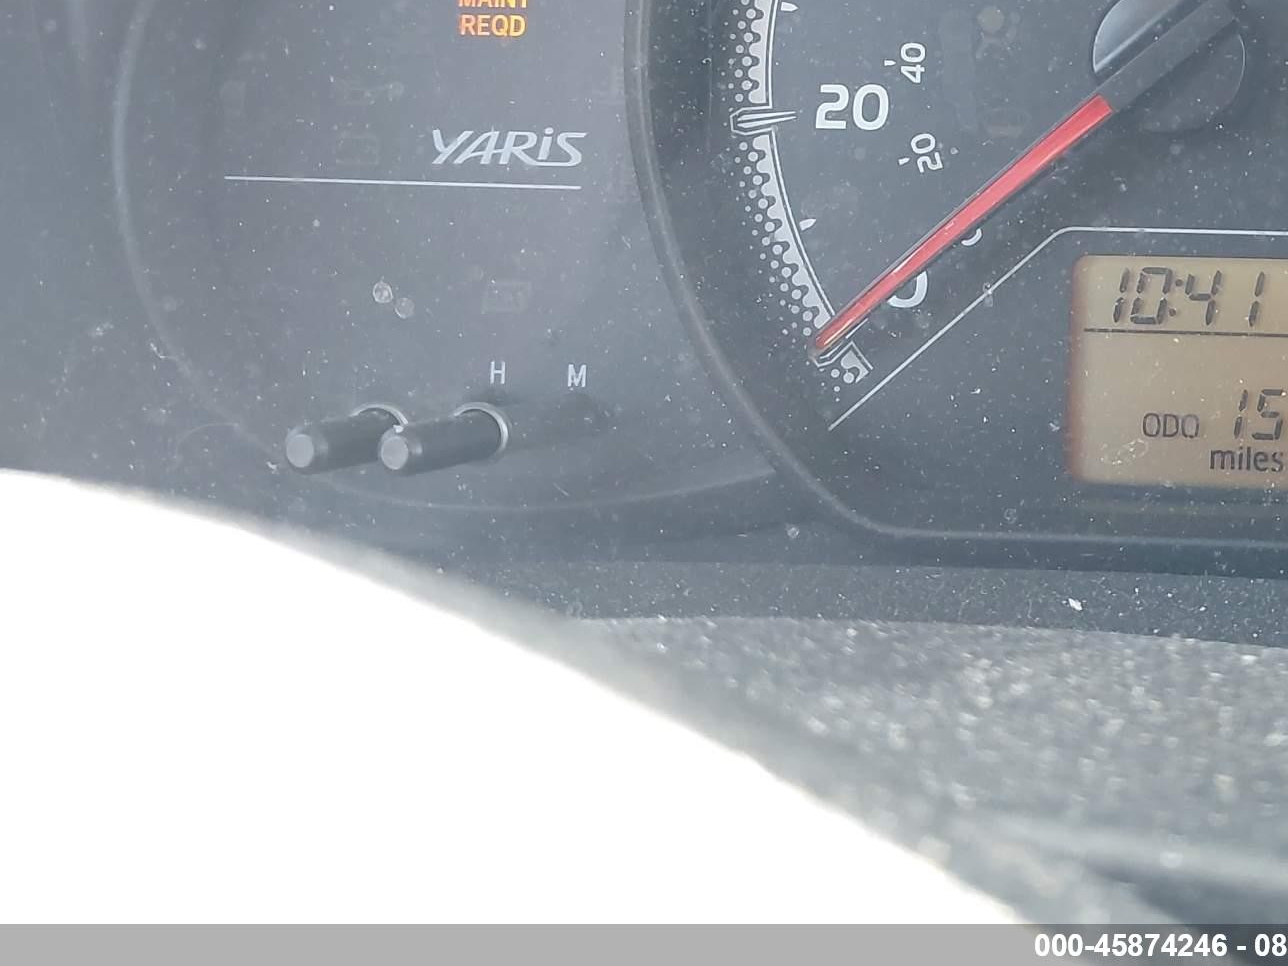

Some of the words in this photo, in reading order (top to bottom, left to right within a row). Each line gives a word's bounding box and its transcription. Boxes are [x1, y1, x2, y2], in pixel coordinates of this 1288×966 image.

[459, 14, 526, 37] REQD
[900, 42, 926, 83] 40
[815, 84, 889, 131] 20
[911, 133, 943, 173] 20
[1112, 266, 1265, 326] 10:41
[490, 361, 506, 384] H
[567, 364, 587, 388] M
[1142, 413, 1200, 438] ODO
[1210, 447, 1284, 472] miles
